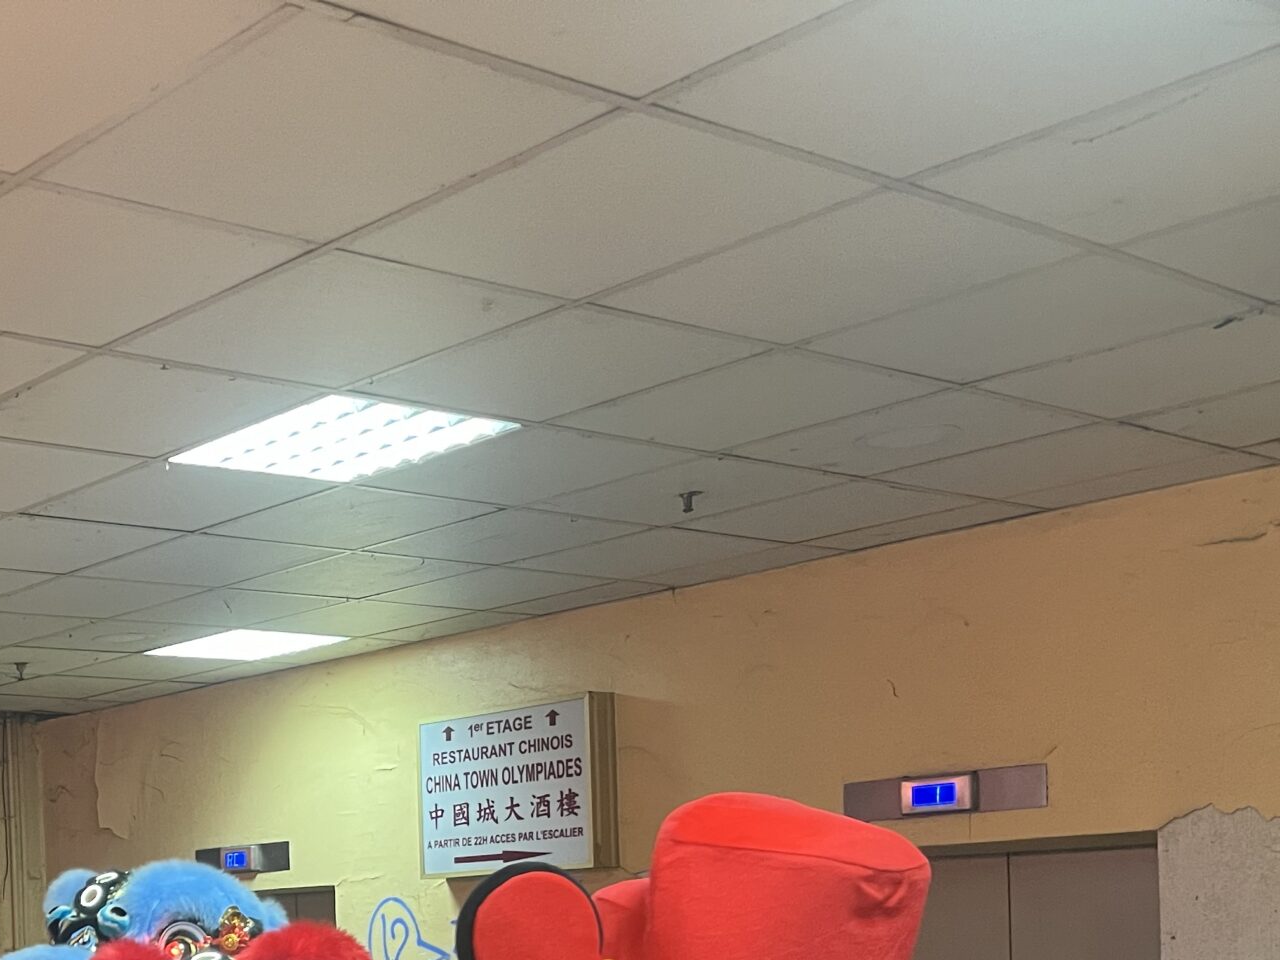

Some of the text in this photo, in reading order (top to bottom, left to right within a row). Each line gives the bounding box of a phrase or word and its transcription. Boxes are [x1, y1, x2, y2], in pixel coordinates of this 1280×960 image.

[468, 716, 532, 737] 1er ETAGE
[433, 734, 573, 766] RESTAURANT CHINOIS
[426, 757, 582, 794] CHINA TOWN OLYMPIADES
[429, 788, 581, 830] 中國城大酒樓
[428, 827, 584, 849] A PARTIR DE 22H ACCES PAR L'ESCALIER
